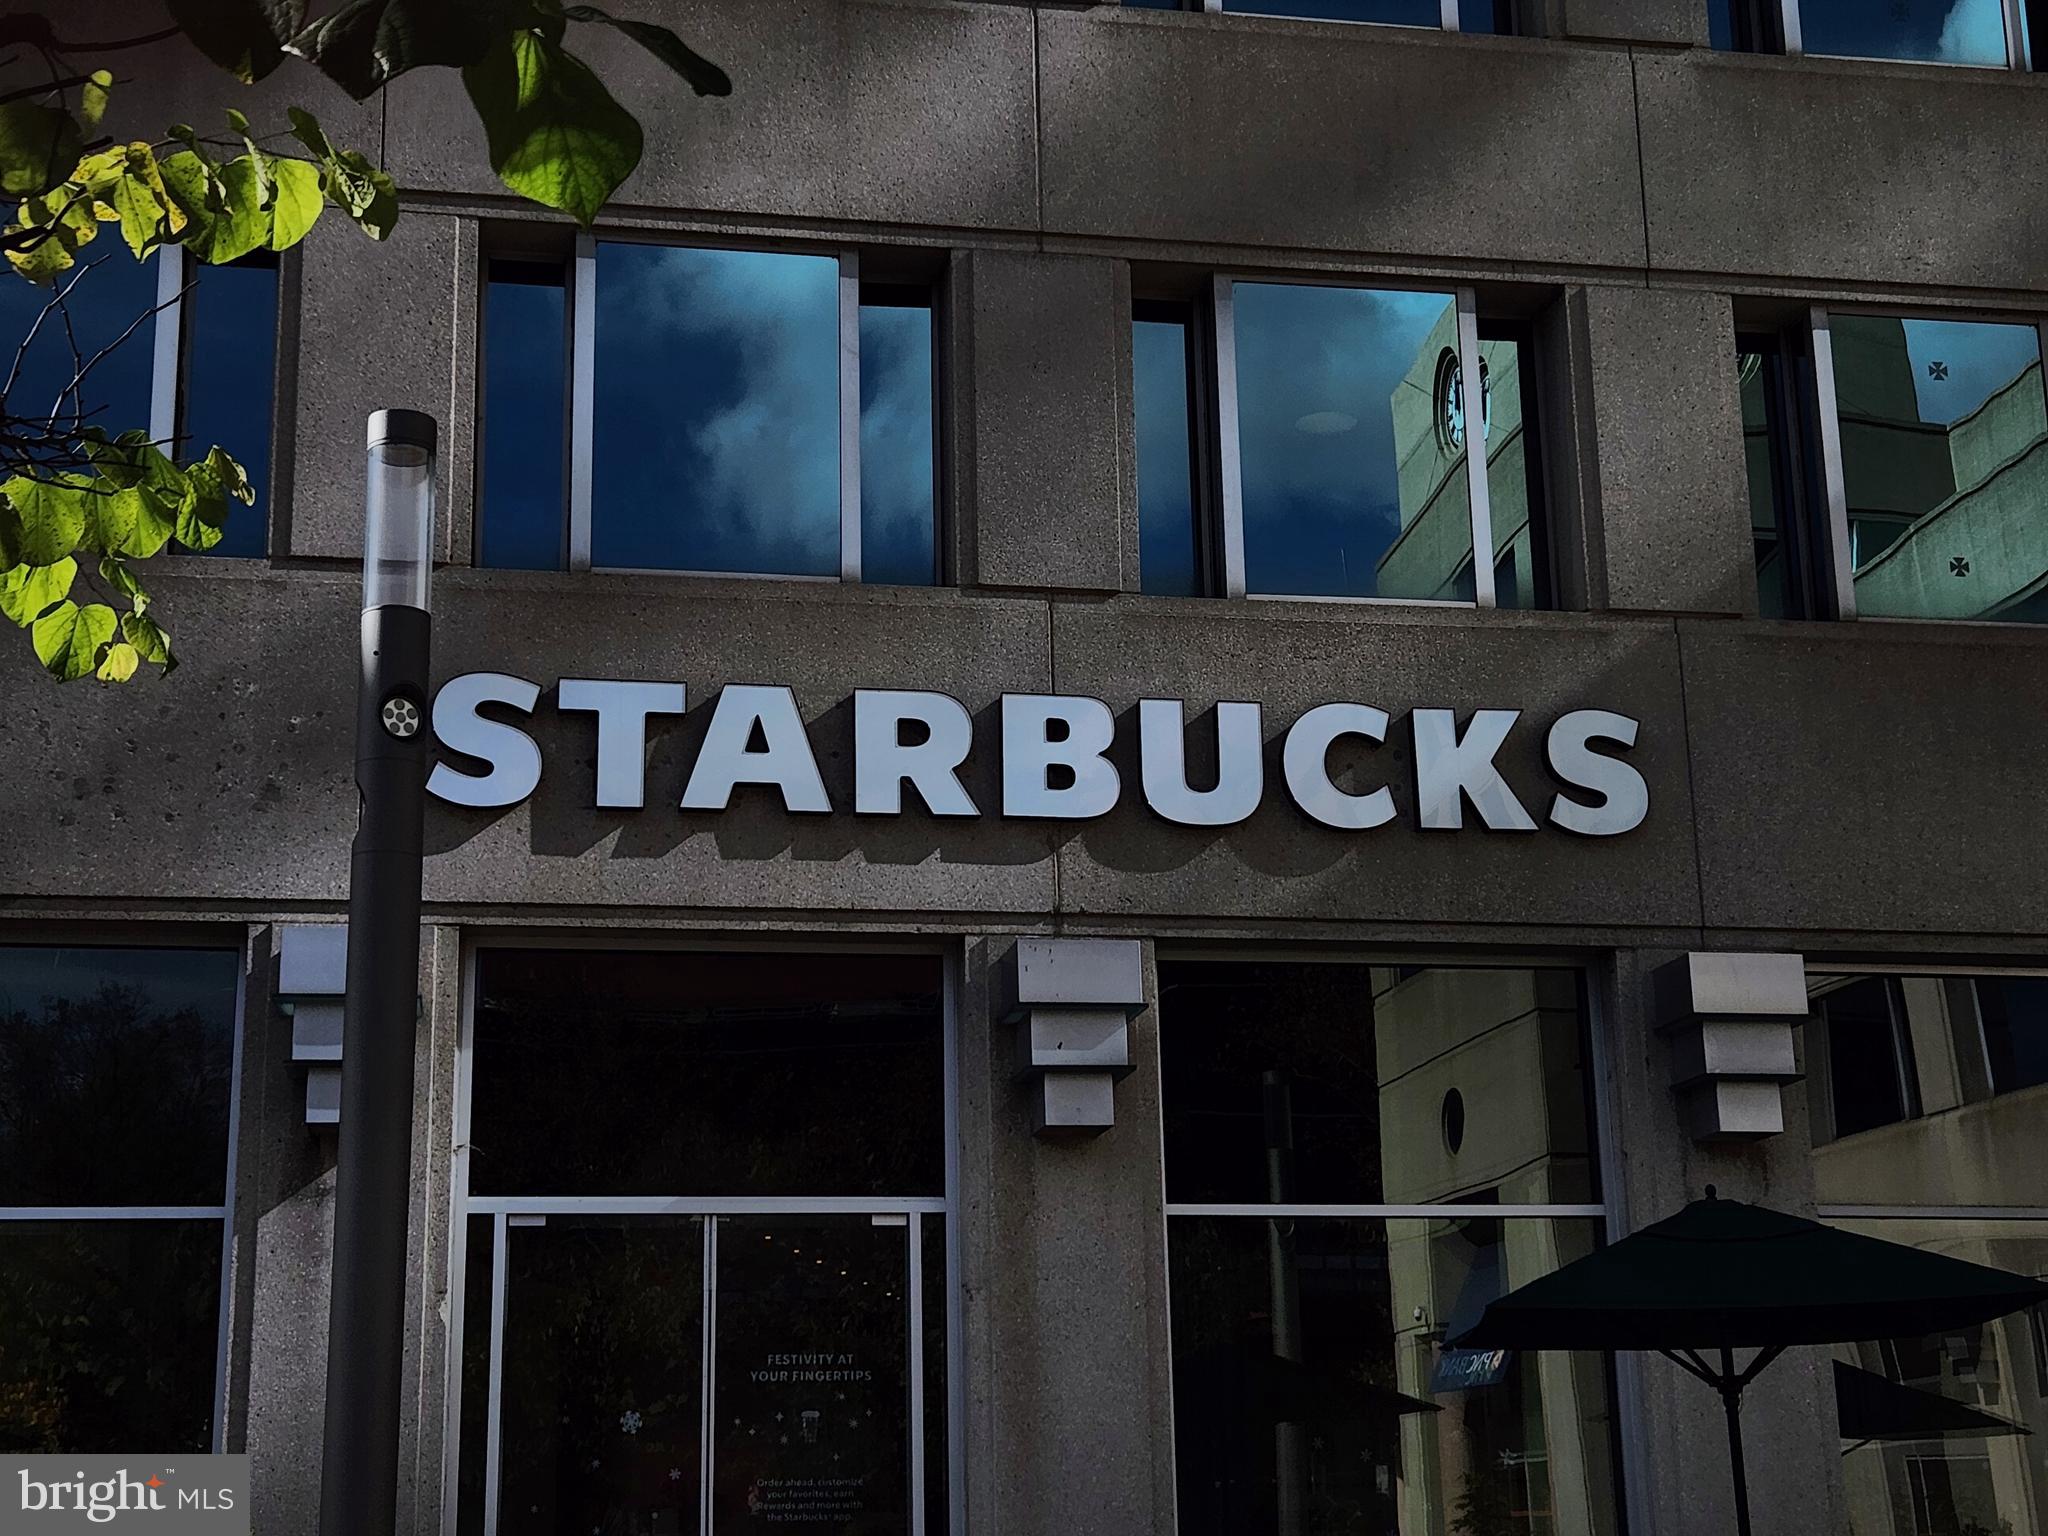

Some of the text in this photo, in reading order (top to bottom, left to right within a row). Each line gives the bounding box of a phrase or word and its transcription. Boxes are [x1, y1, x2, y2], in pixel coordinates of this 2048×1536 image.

[424, 671, 1650, 836] STARBUCKS
[767, 1353, 854, 1366] FESTIVITY AT
[750, 1370, 873, 1383] YOUR FINGERTIPS
[756, 1478, 784, 1487] Order
[766, 1490, 786, 1500] your
[797, 1501, 815, 1510] and
[816, 1502, 840, 1510] more
[841, 1500, 864, 1510] with
[766, 1512, 784, 1522] the
